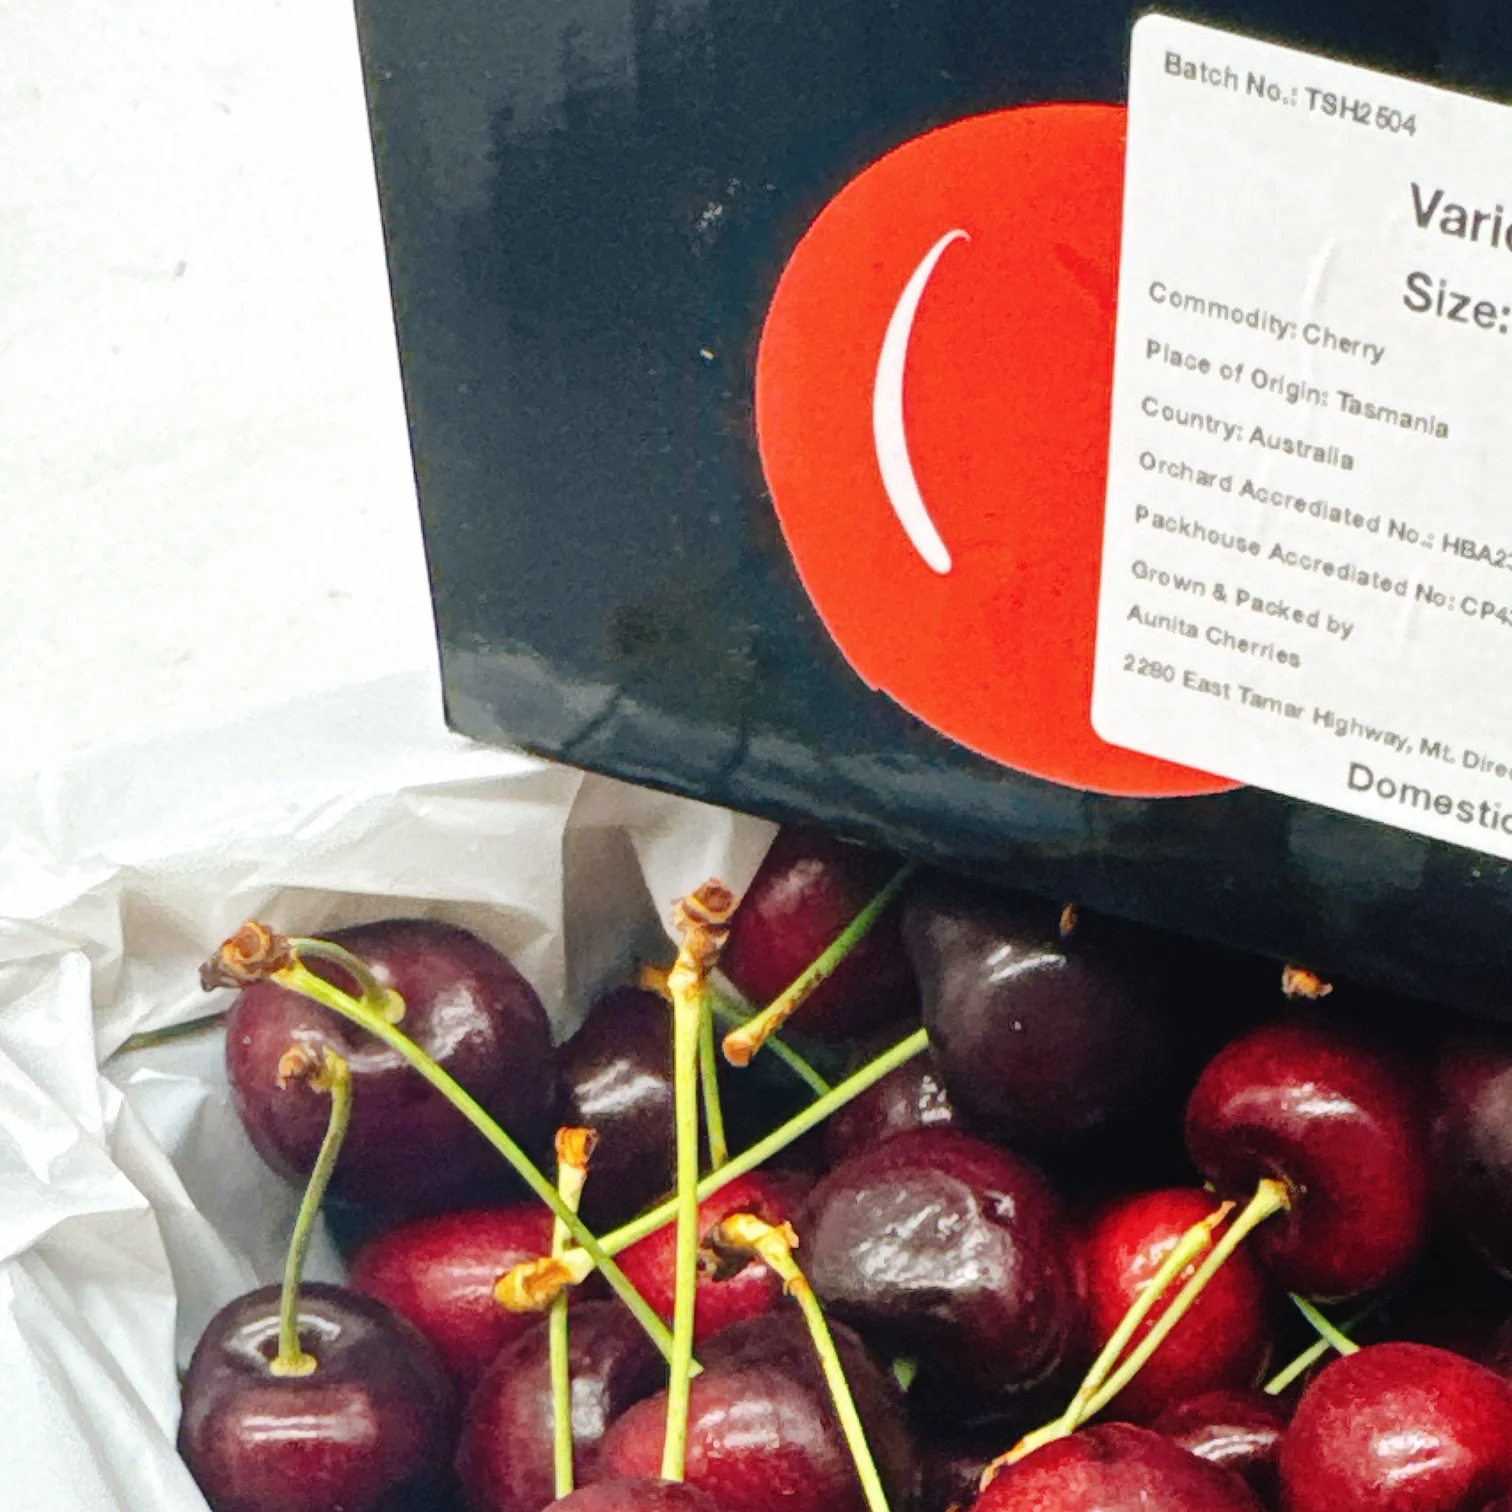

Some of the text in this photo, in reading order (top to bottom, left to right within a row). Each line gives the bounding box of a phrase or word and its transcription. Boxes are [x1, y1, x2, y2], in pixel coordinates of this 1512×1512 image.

[1163, 50, 1239, 92] Batch
[1148, 280, 1386, 366] Commodity: Cherry
[1402, 270, 1512, 335] Size:
[1145, 338, 1449, 439] Place of Origin: Tasmania
[1140, 395, 1355, 471] Country: Australia
[1138, 450, 1234, 493] Orchard
[1238, 478, 1381, 534] Accrediated
[1135, 503, 1262, 557] Packhouse
[1267, 542, 1409, 597] Accrediated
[1414, 582, 1456, 611] No:
[1126, 603, 1301, 669] Aunita Cherries
[1131, 559, 1355, 642] Grown & Packed by
[1122, 652, 1176, 684] 2280
[1182, 669, 1231, 701] East
[1237, 684, 1305, 719] Tamar
[1312, 706, 1414, 755] Highway,
[1419, 737, 1456, 765] Mt.
